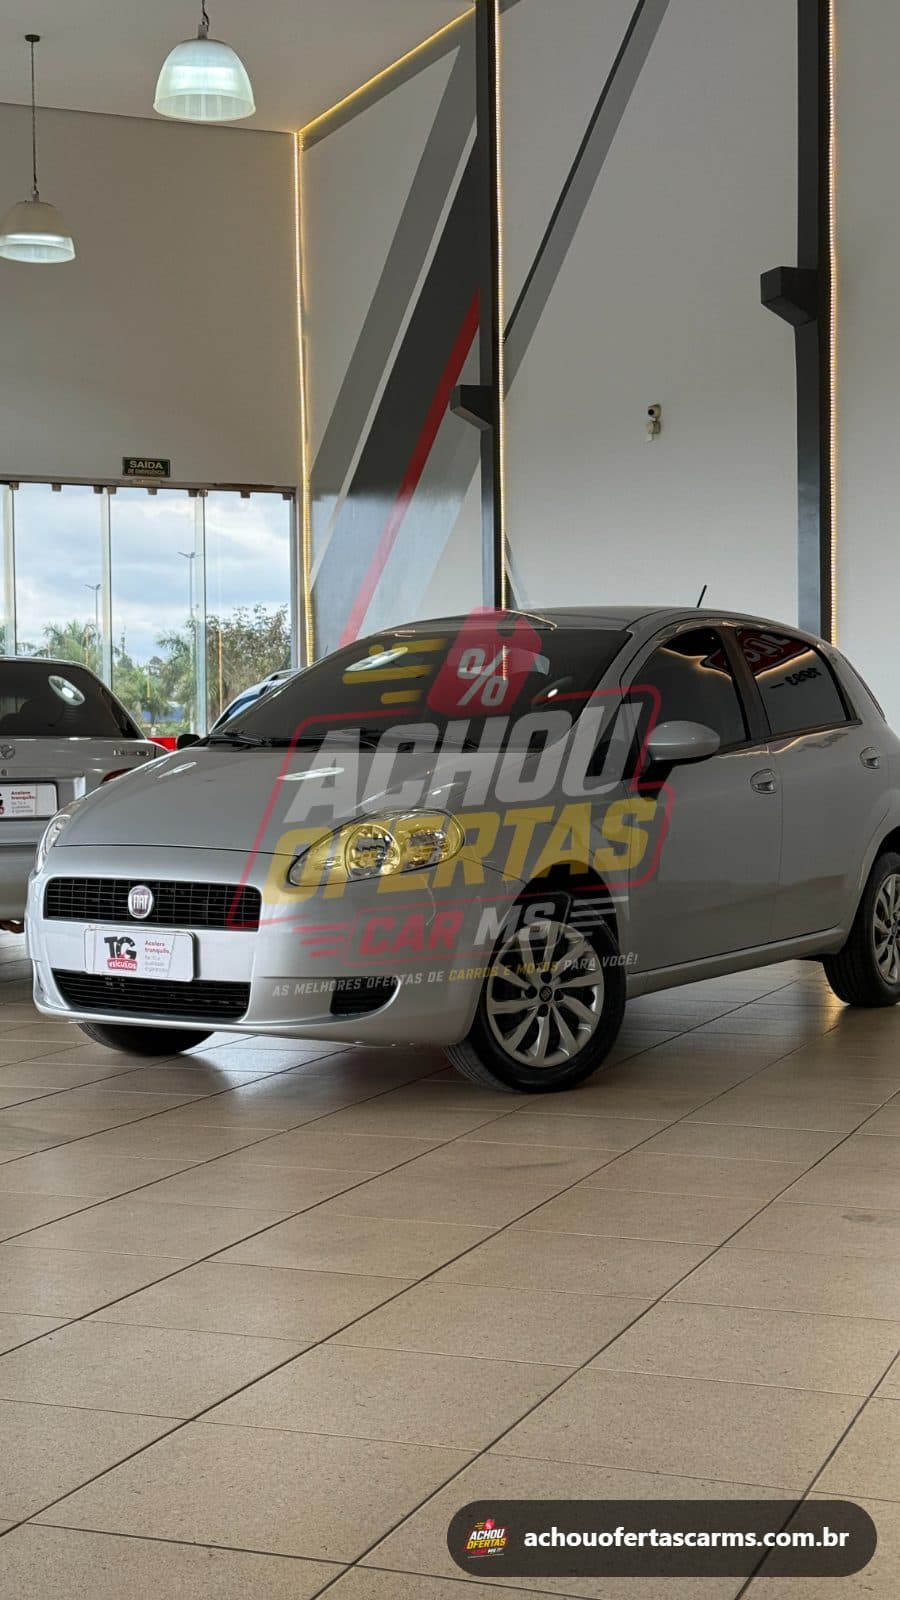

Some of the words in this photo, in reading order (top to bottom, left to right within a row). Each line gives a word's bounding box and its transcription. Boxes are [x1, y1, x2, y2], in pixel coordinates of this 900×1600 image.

[130, 460, 163, 469] SAÍDA
[133, 894, 149, 910] FIAT
[104, 936, 137, 960] TG
